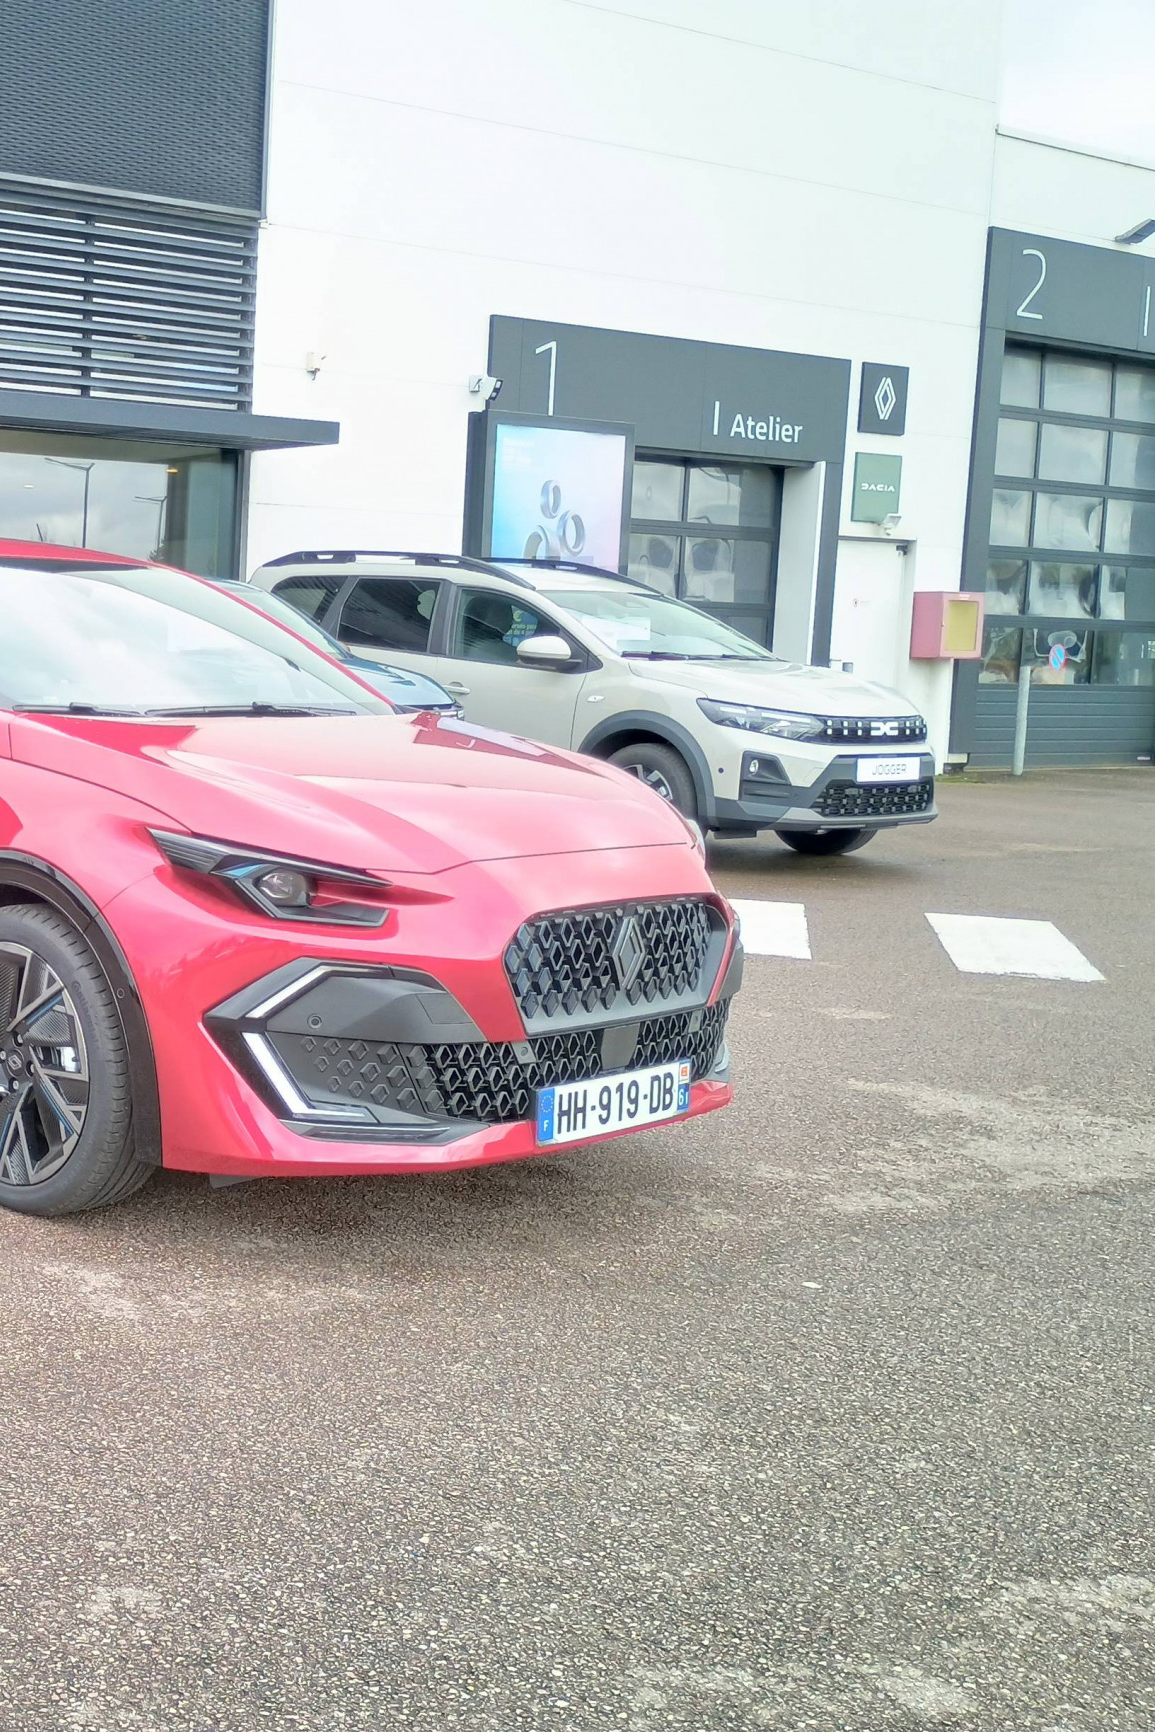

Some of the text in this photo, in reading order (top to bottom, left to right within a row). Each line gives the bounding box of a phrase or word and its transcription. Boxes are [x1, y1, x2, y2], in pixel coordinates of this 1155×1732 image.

[1016, 248, 1047, 320] 2
[535, 340, 557, 416] 1
[729, 413, 803, 443] Atelier
[861, 482, 896, 492] DACIA
[872, 763, 907, 776] JOGGER
[543, 1120, 549, 1132] F
[557, 1072, 674, 1134] HH-919-DB
